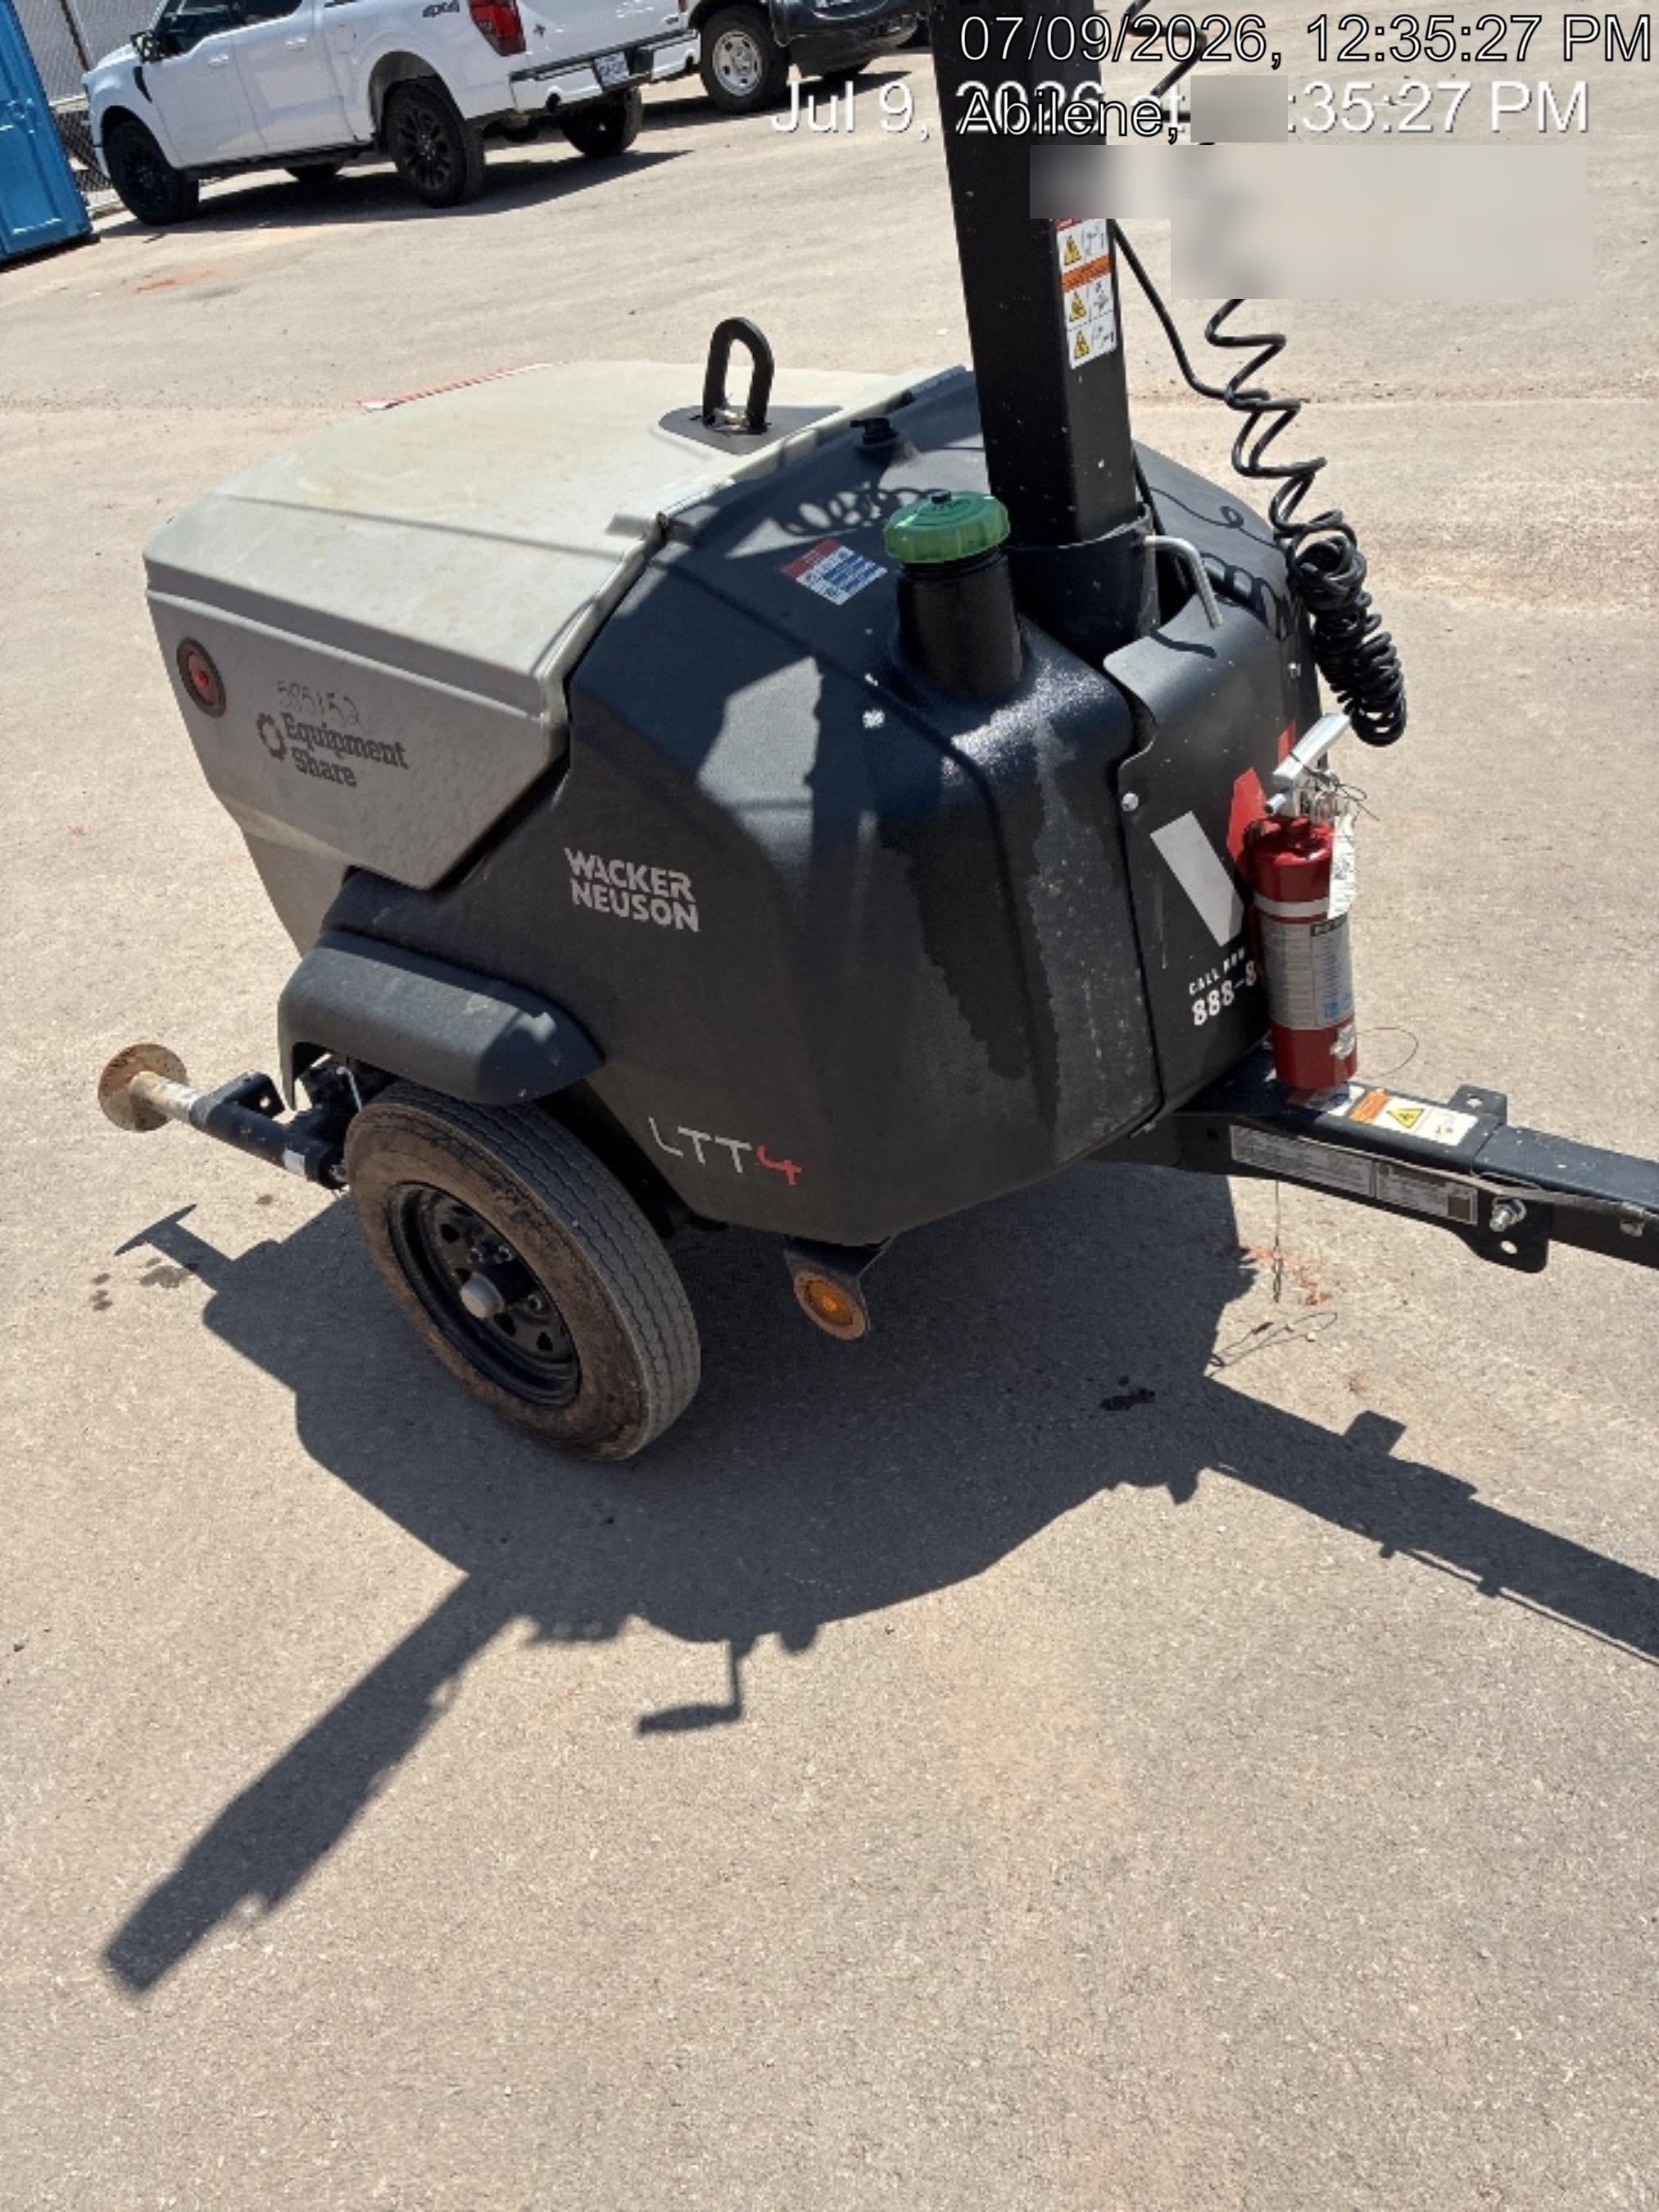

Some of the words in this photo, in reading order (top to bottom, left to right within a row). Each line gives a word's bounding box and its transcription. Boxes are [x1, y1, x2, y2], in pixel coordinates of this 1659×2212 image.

[280, 712, 409, 769] Equipment
[291, 746, 358, 788] Share
[564, 846, 696, 902] WACKER
[569, 876, 700, 932] NEUSON
[1189, 968, 1220, 996] CALL
[648, 1115, 803, 1185] LTT4
